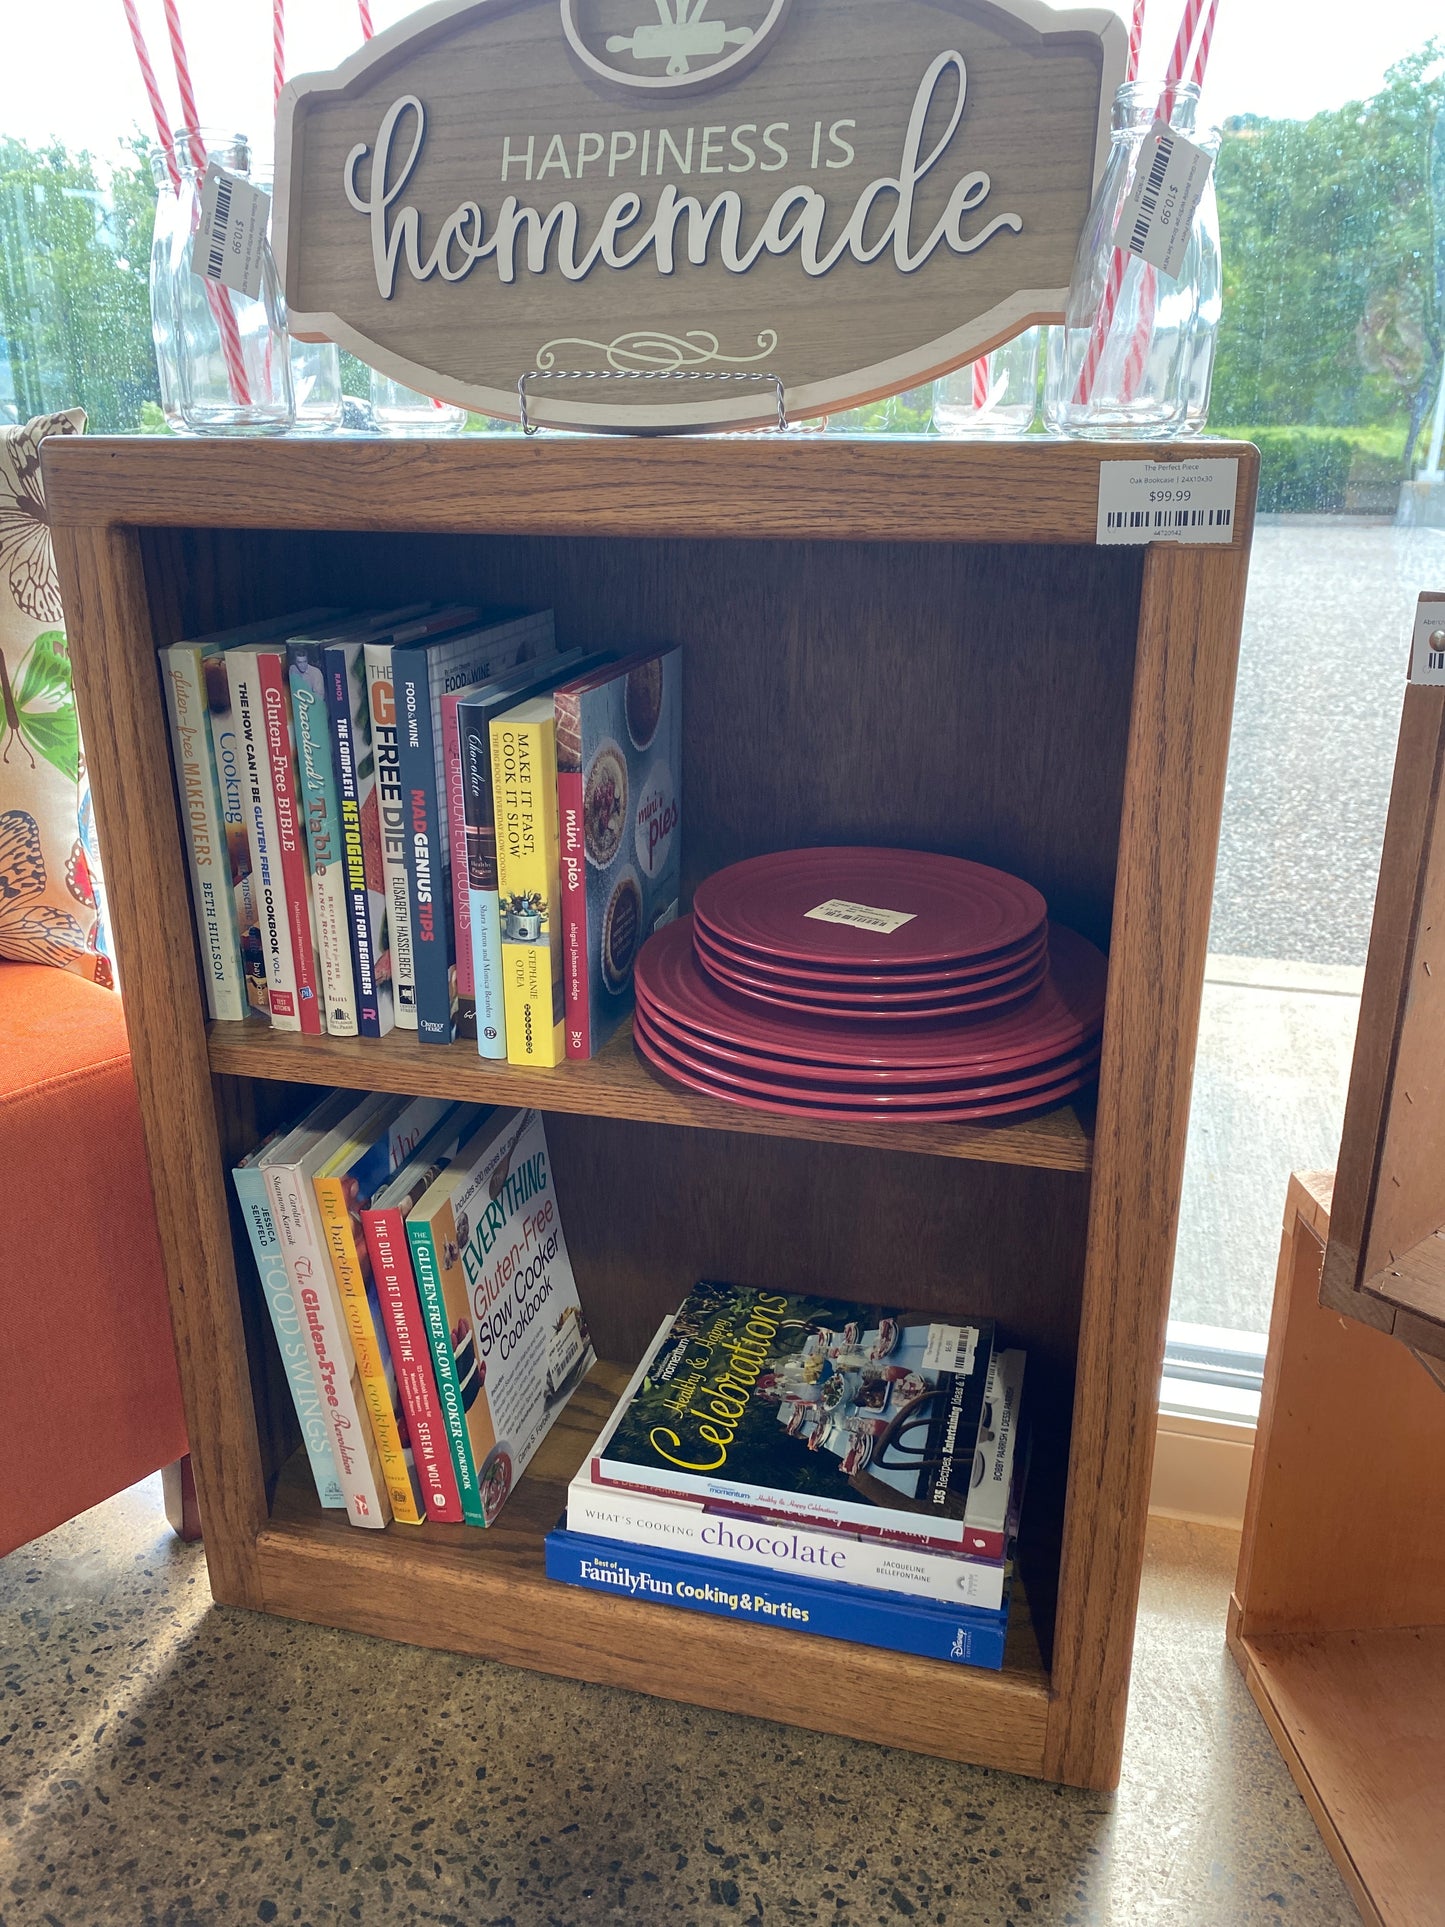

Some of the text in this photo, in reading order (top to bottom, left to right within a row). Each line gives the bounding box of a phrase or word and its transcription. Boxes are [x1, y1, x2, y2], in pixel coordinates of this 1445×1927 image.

[344, 50, 1023, 299] homemade
[501, 119, 857, 181] HAPPINESS IS
[1160, 184, 1179, 225] $10.99
[231, 219, 245, 255] $10.99
[1144, 476, 1175, 484] Bookcase
[1149, 490, 1192, 502] $99.99
[238, 682, 249, 707] THE
[334, 673, 342, 701] RAMOS
[369, 665, 393, 680] THE
[168, 670, 198, 760] gluten-free
[241, 709, 254, 742] HOW
[293, 688, 325, 793] Graceland's
[219, 732, 244, 825] Cooking
[246, 744, 257, 770] CAN
[249, 769, 259, 786] IT
[265, 687, 296, 852] Gluten-Free BIBLE
[466, 728, 486, 797] Chocolate
[183, 762, 213, 867] MAKEOVERS
[251, 786, 261, 803] BE
[451, 758, 466, 838] CHOCOLATE
[496, 796, 504, 831] EVERYDAY
[502, 732, 521, 858] COOK IT SLOW
[518, 733, 535, 856] MAKE IT FAST,
[254, 805, 267, 854] GLUTEN
[308, 797, 332, 877] Table
[336, 718, 373, 996] THE COMPLETE KETOGENIC DIET FOR BEGINNERS
[455, 839, 469, 869] CHIP
[563, 808, 581, 893] mini pies
[638, 796, 679, 871] mini pies
[259, 855, 271, 886] FREE
[499, 851, 508, 886] COOKING
[264, 888, 279, 954] COOKBOOK
[317, 883, 330, 951] KING ROCK
[392, 877, 412, 979] ELISABETH HASSELBECK
[457, 871, 472, 930] COOKIES
[479, 904, 487, 925] Shara
[202, 882, 225, 981] BETH HILLSON
[253, 962, 262, 978] bay
[515, 959, 525, 989] O'DEA
[528, 949, 538, 1000] STEPHANIE
[391, 1126, 421, 1168] the
[272, 1174, 297, 1246] Shannon-Karasik
[287, 1193, 302, 1228] Caroline
[454, 1153, 502, 1214] Includes 300 recipes
[251, 1204, 268, 1247] SEINFELD
[261, 1207, 276, 1244] JESSICA
[412, 1231, 428, 1239] THE
[462, 1151, 548, 1287] EVERYTHING
[293, 1255, 314, 1286] The
[473, 1199, 554, 1321] Gluten-Free
[373, 1219, 415, 1363] THE DUDE DIET DINNERTIME
[416, 1246, 446, 1340] GLUTEN-FREE
[479, 1294, 514, 1358] Slow
[513, 1227, 559, 1303] Cooker
[500, 1275, 554, 1360] Cookbook
[260, 1252, 332, 1454] FOOD SWINGS
[301, 1288, 339, 1408] Gluten-Free
[321, 1191, 338, 1221] the
[330, 1222, 357, 1297] barefoot
[351, 1303, 374, 1379] contessa
[368, 1384, 398, 1464] cookbook
[434, 1341, 453, 1381] SLOW
[650, 1292, 788, 1471] Celebrations
[660, 1337, 691, 1381] momentum
[663, 1318, 735, 1420] Healthy Happy
[442, 1383, 464, 1438] COOKER
[536, 1413, 551, 1435] Forbes
[331, 1409, 356, 1476] Revolution
[417, 1422, 435, 1460] SERENA
[426, 1463, 442, 1489] WOLF
[455, 1439, 473, 1491] COOKBOOK
[933, 1383, 966, 1505] 135 Recipes, Entertaining Ideas
[993, 1409, 1010, 1482] BOBBY PARRISH DESSI
[709, 1487, 751, 1500] momentum
[585, 1509, 847, 1569] WHAT'S COOKING chocolate
[594, 1557, 618, 1569] Best of
[883, 1560, 926, 1574] JACQUELINE
[579, 1560, 810, 1622] FamilyFun Cooking & Parties
[876, 1567, 931, 1583] BELLEFONTAINE
[950, 1627, 968, 1658] Disney
